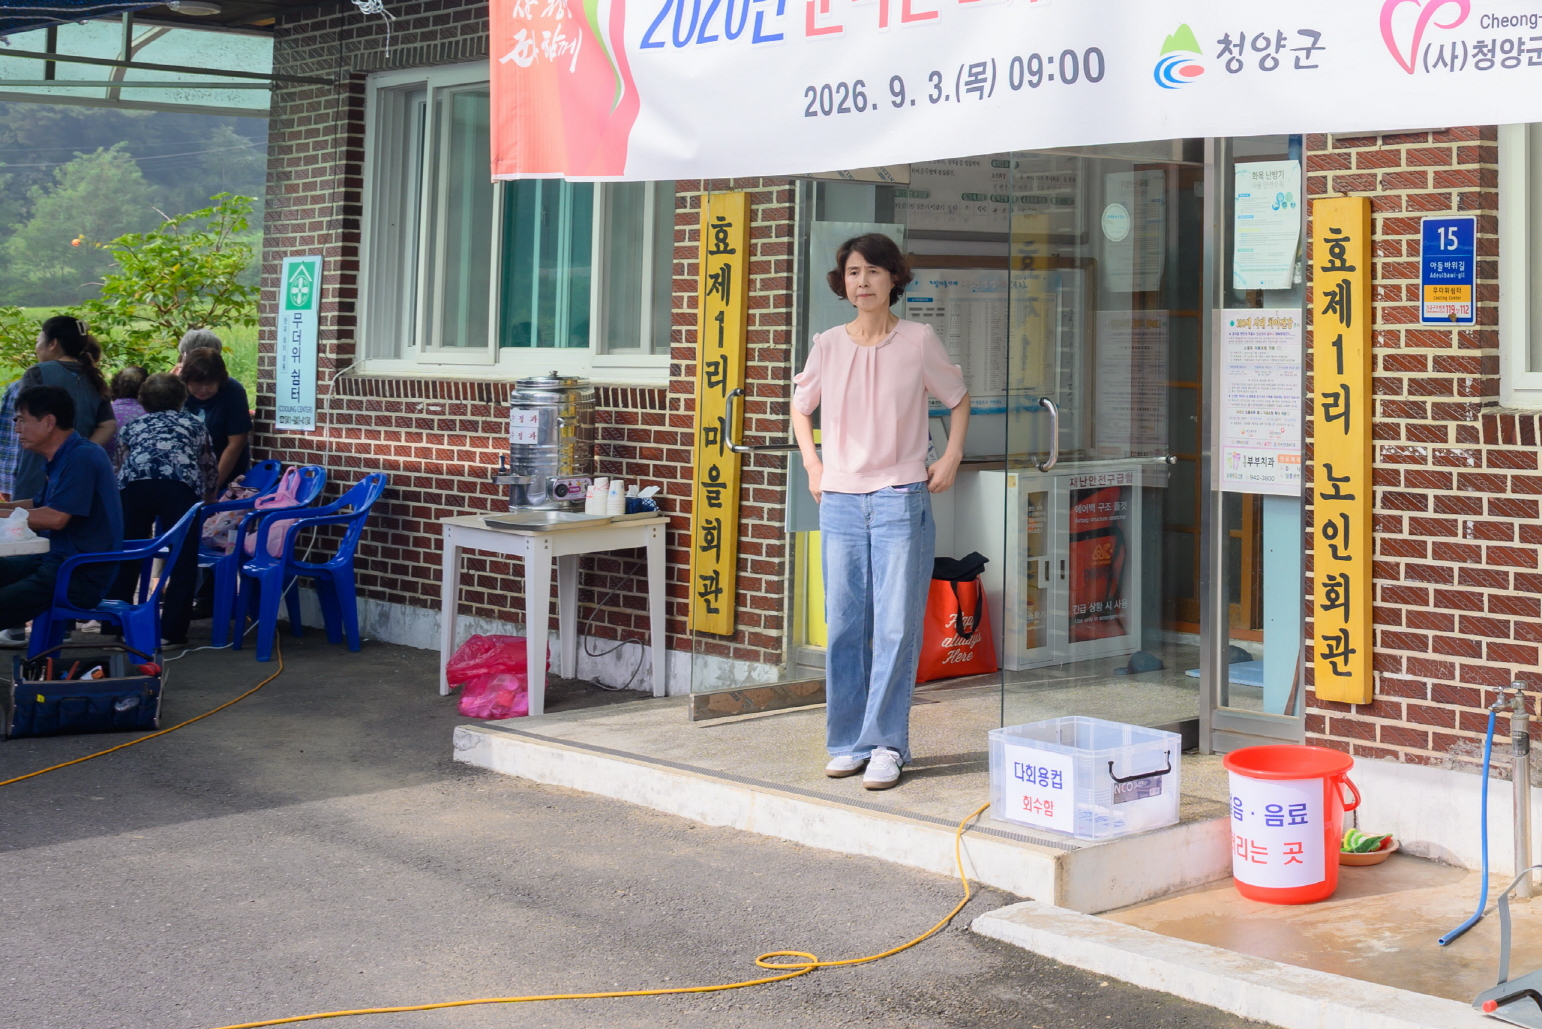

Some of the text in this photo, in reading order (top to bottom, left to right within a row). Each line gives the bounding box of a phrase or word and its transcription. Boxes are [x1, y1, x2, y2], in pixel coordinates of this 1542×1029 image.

[1215, 27, 1327, 76] 청양군
[803, 81, 878, 119] 2026.
[1008, 46, 1106, 92] 09:00
[1437, 226, 1458, 250] 15
[1429, 261, 1465, 271] 아들바위길
[704, 215, 737, 398] 효제1리
[1445, 304, 1456, 314] 119
[1459, 304, 1470, 314] 112
[290, 312, 303, 403] 무더위 쉼터
[1247, 456, 1275, 468] 부부치과
[1319, 227, 1357, 678] 효제1리 노인회관
[1069, 472, 1134, 488] 재난안전구급함
[1098, 502, 1112, 512] 구조
[1072, 599, 1129, 615] 긴급 상황 시 사용
[942, 649, 974, 664] Here
[1013, 760, 1064, 791] 다회용컵
[1022, 794, 1056, 818] 회수함
[1264, 802, 1309, 828] 음료
[1283, 841, 1305, 866] 곳
